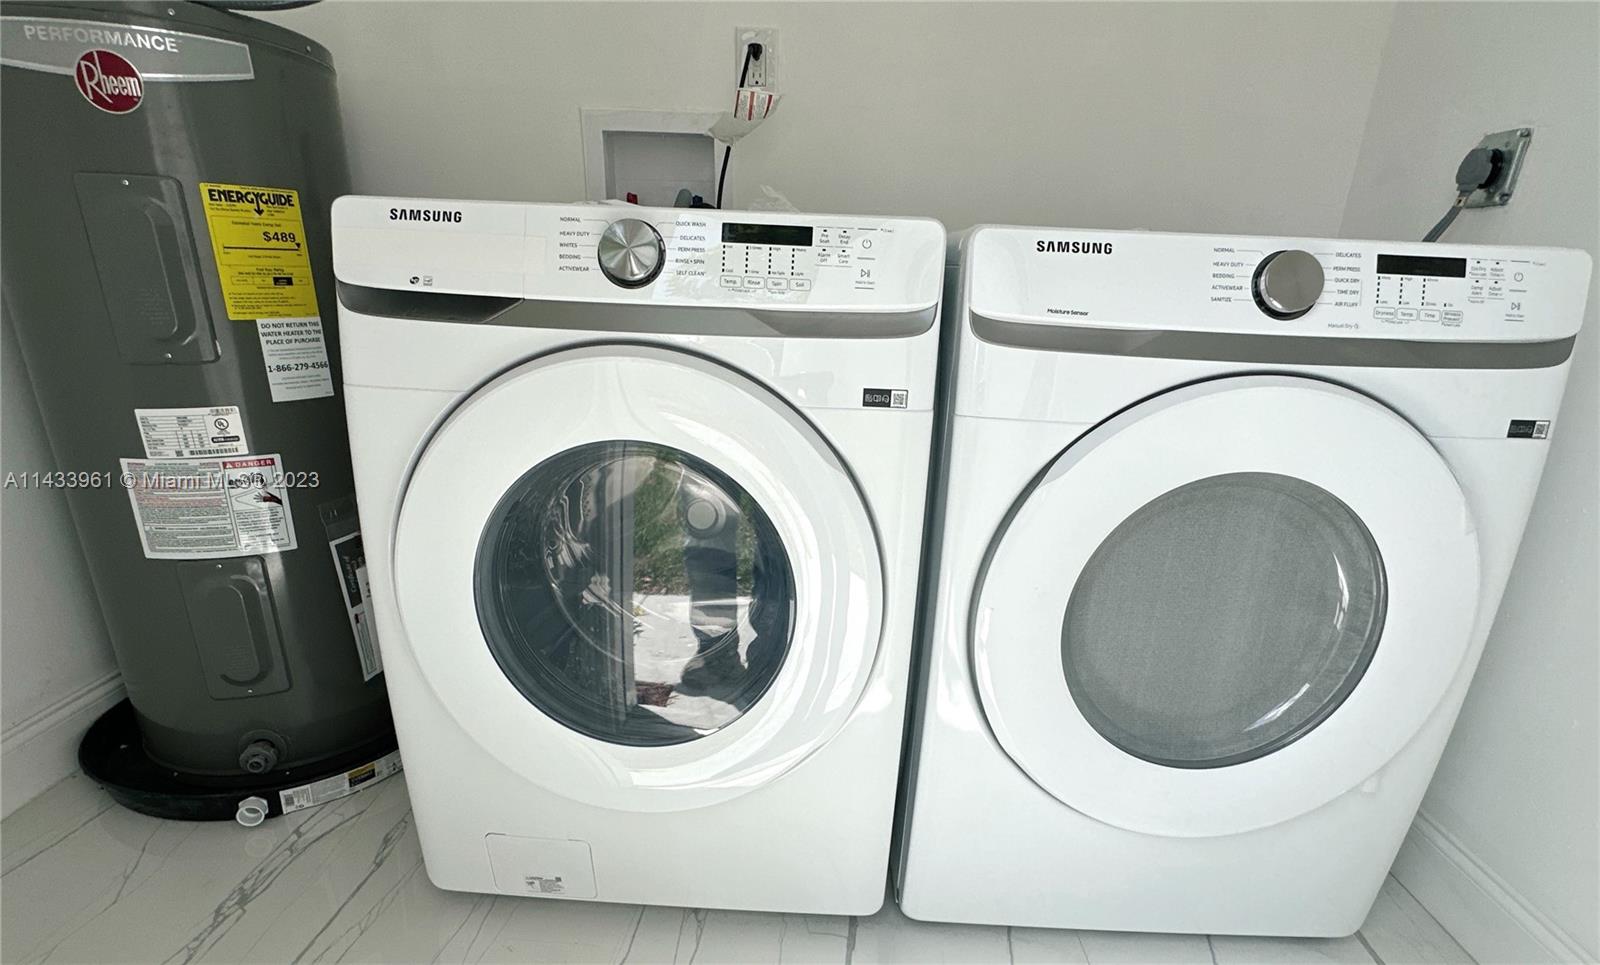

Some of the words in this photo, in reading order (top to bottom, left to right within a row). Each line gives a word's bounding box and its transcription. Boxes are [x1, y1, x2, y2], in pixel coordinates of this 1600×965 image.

[24, 24, 178, 53] PERFORMANCE
[80, 51, 142, 103] Rheem
[207, 188, 295, 208] ENERGYGUIDE
[389, 207, 463, 224] SAMSUNG
[262, 231, 296, 243] $489
[1035, 240, 1113, 255] SAMSUNG
[1047, 308, 1070, 316] Moisture
[1070, 309, 1089, 317] Sensor
[267, 360, 329, 373] 1-866-279-4566
[235, 459, 272, 468] DANGER
